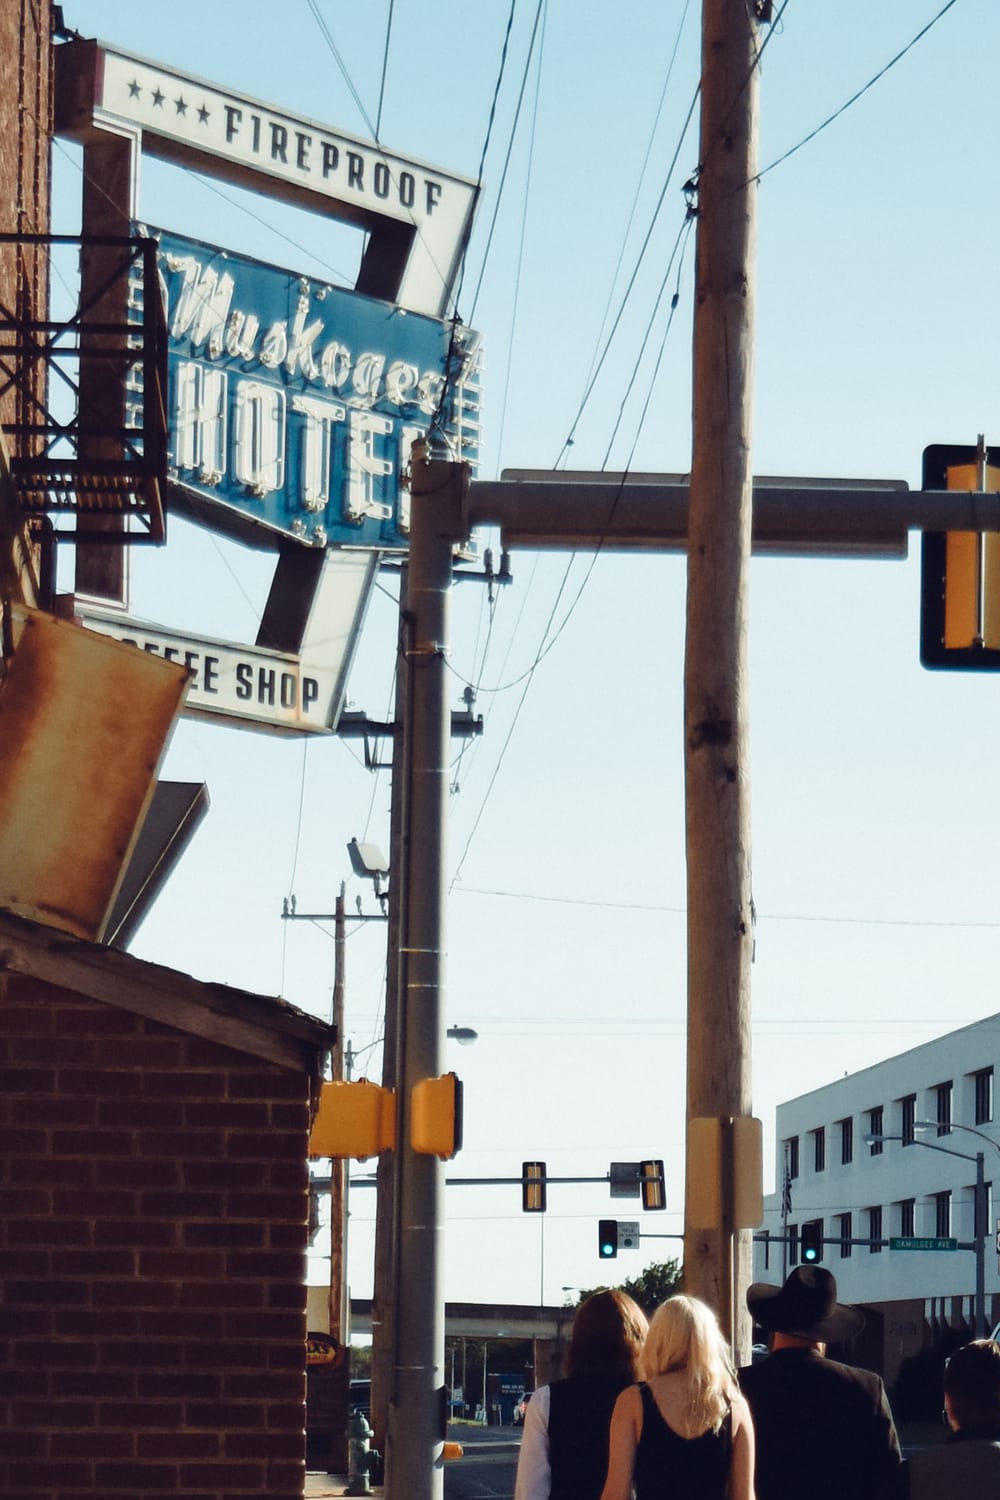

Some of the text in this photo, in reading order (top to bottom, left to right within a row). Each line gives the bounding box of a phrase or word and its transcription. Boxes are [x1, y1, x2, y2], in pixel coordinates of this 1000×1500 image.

[223, 104, 443, 216] FIREPROOF
[165, 252, 448, 415] Muskogee
[235, 662, 319, 713] SHOP
[937, 1239, 950, 1249] AVE
